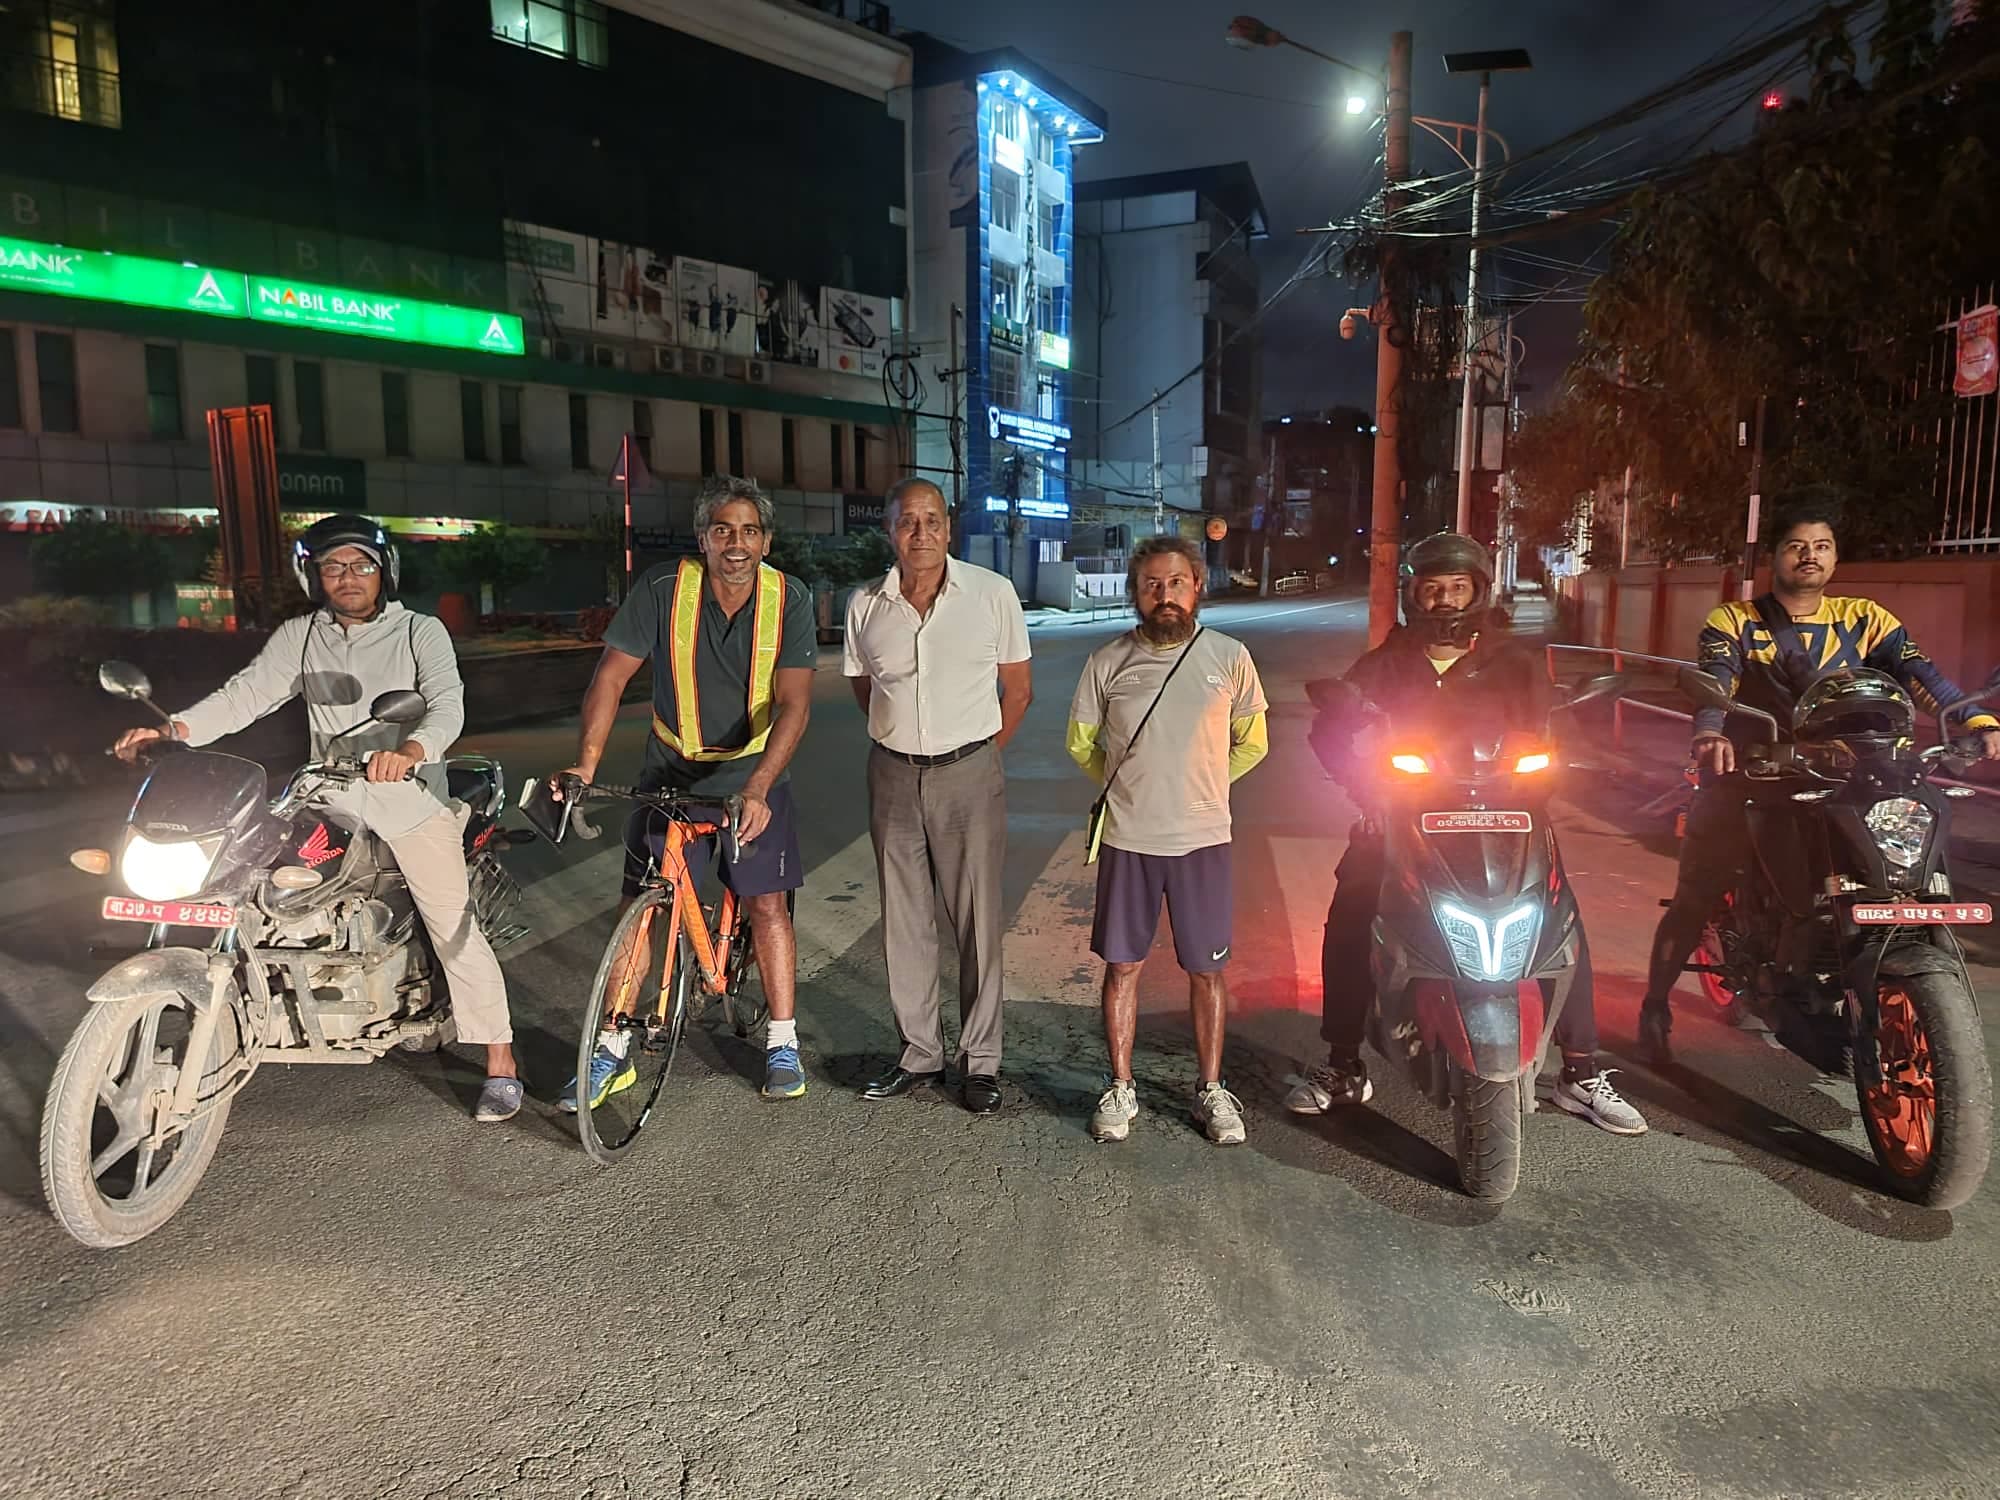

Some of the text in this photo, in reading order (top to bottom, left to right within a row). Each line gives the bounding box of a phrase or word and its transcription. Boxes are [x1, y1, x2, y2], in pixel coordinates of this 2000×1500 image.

[296, 240, 484, 298] BANK
[258, 286, 329, 312] NABIL
[333, 297, 394, 322] BANK
[848, 503, 887, 520] BHAG
[146, 821, 190, 832] HONDA
[304, 846, 345, 869] HONDA
